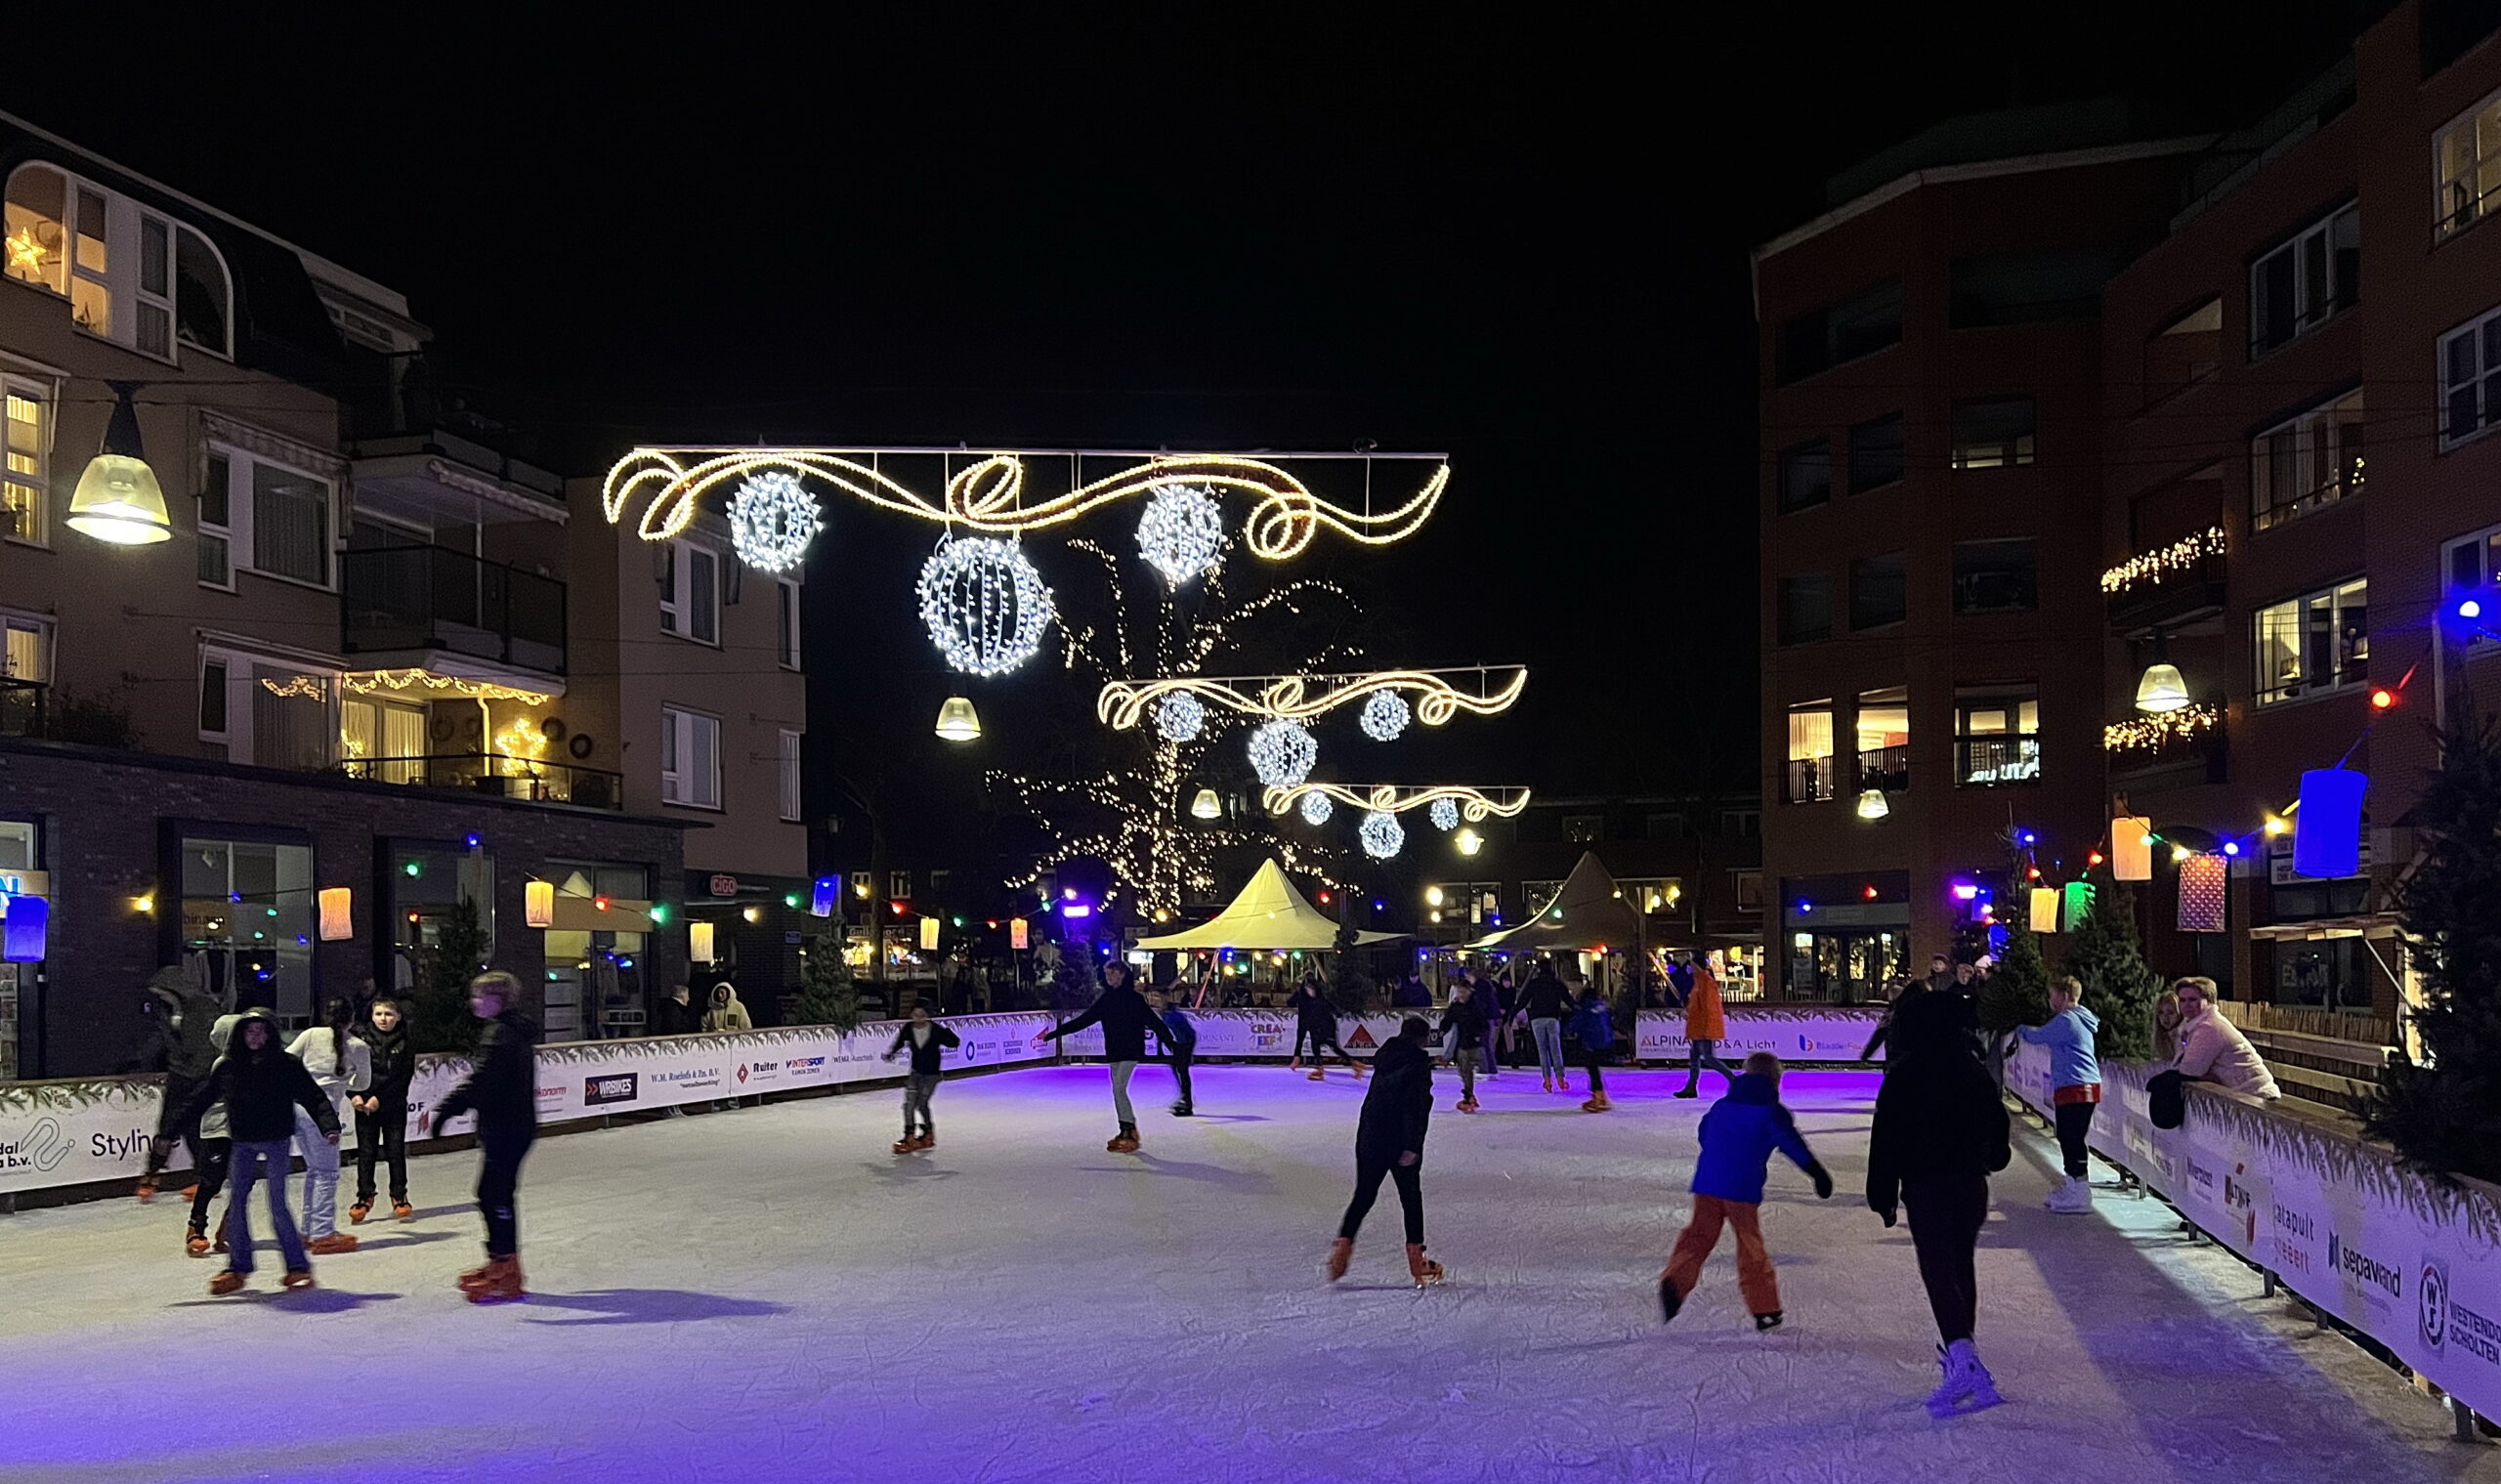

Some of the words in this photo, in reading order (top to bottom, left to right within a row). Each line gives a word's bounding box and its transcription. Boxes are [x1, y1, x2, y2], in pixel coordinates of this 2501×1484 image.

[1747, 1039, 1777, 1050] Licht
[753, 1062, 778, 1073] Ruiter
[91, 1128, 162, 1162] Stylin
[2450, 1324, 2500, 1366] SCHOLTEN
